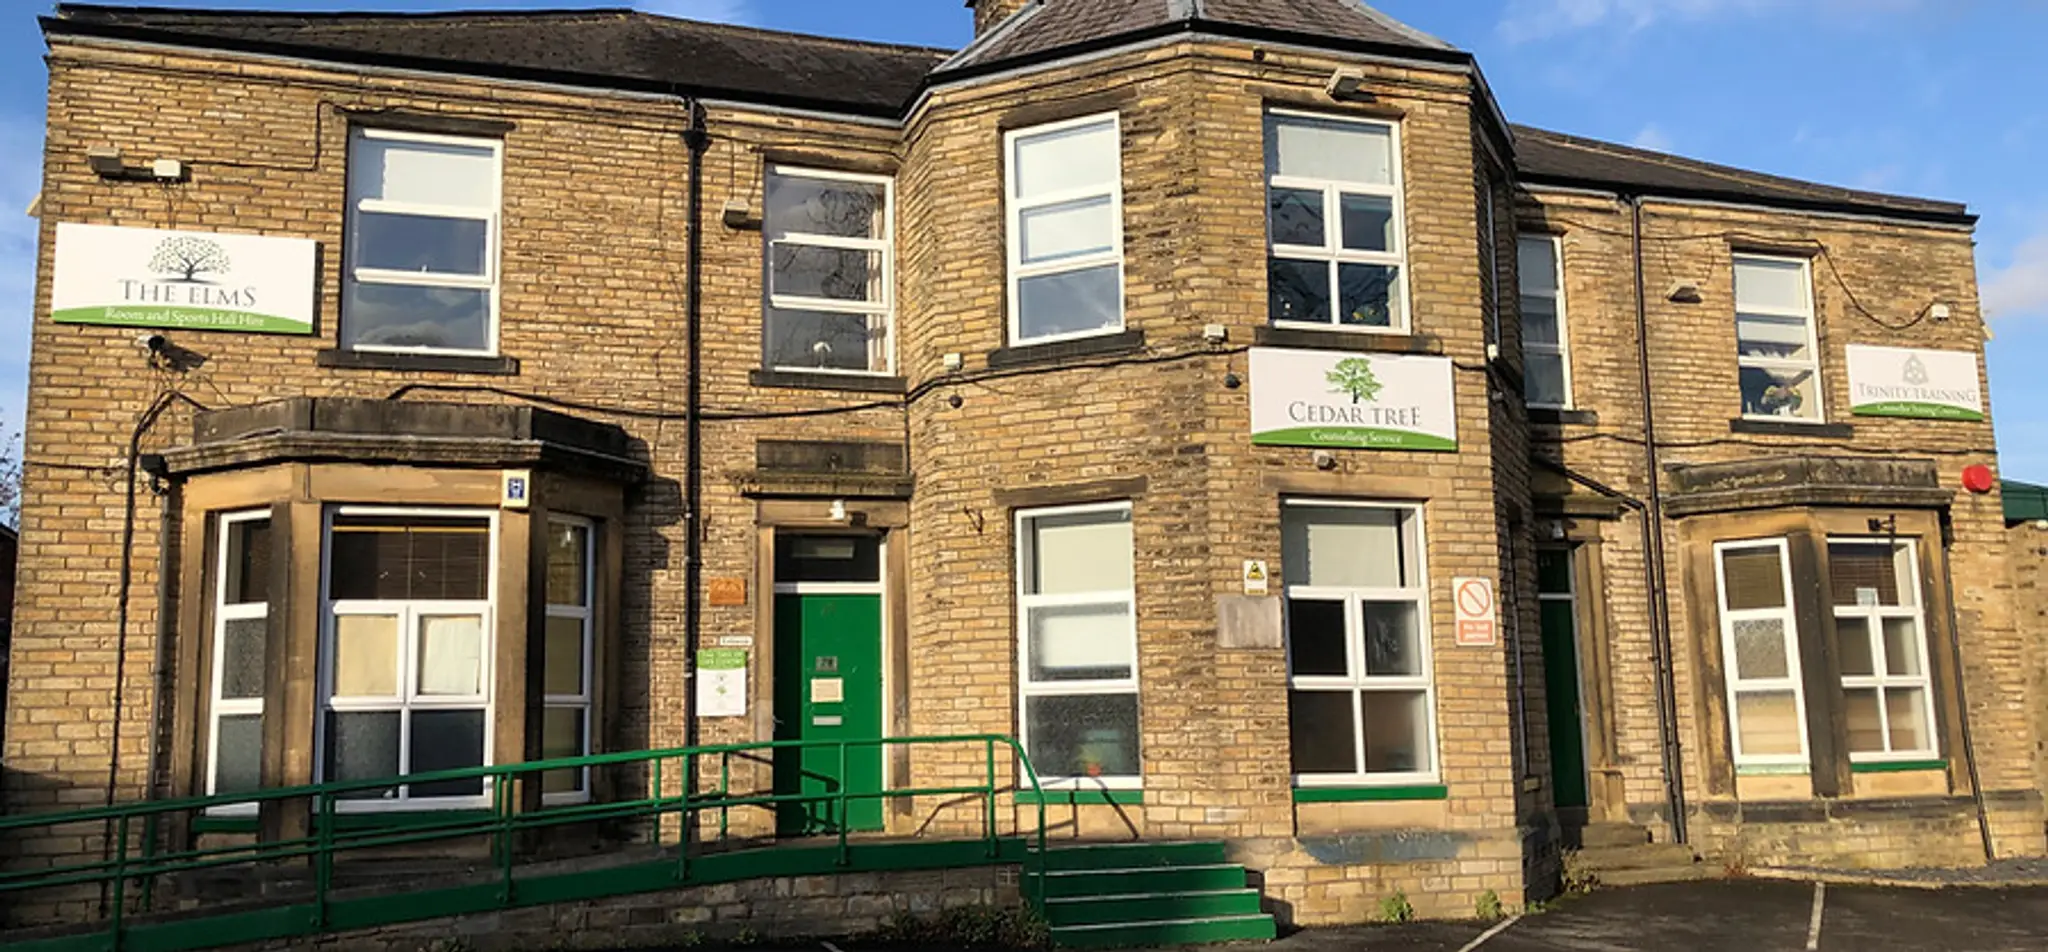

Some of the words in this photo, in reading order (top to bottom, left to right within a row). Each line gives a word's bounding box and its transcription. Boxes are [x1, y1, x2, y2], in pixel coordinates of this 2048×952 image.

[118, 279, 176, 302] THE
[189, 286, 256, 308] ELMS
[104, 306, 144, 321] Room
[146, 309, 170, 322] and
[171, 309, 209, 326] Sports
[211, 312, 237, 325] Hall
[239, 313, 264, 326] Hire
[1857, 383, 1909, 399] TRINITY
[1913, 386, 1977, 402] TRAINING
[1289, 400, 1365, 424] CEDAR
[1369, 405, 1421, 427] TREE
[1309, 428, 1369, 446] Counselling
[1369, 431, 1402, 444] Service
